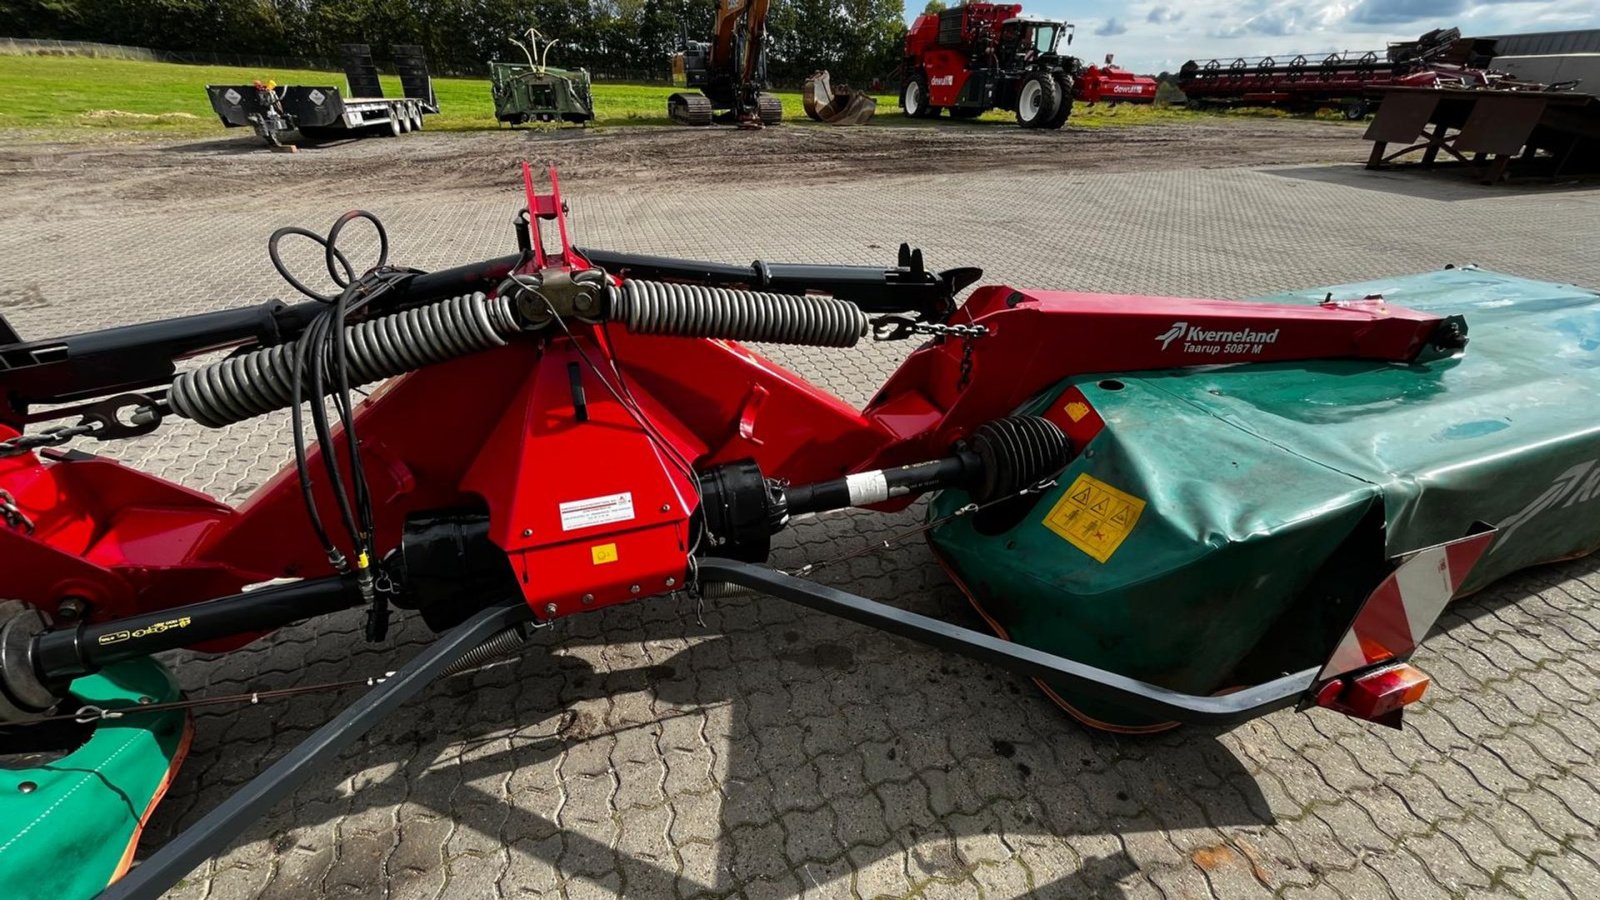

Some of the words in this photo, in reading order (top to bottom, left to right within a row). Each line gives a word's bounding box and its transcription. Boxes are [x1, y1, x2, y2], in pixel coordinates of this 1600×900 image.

[931, 75, 949, 86] dewulf
[1113, 85, 1138, 93] dewulf
[1186, 326, 1279, 343] Kverneland
[1183, 343, 1220, 355] Taarup
[1223, 343, 1250, 354] 5087
[1251, 344, 1263, 354] M
